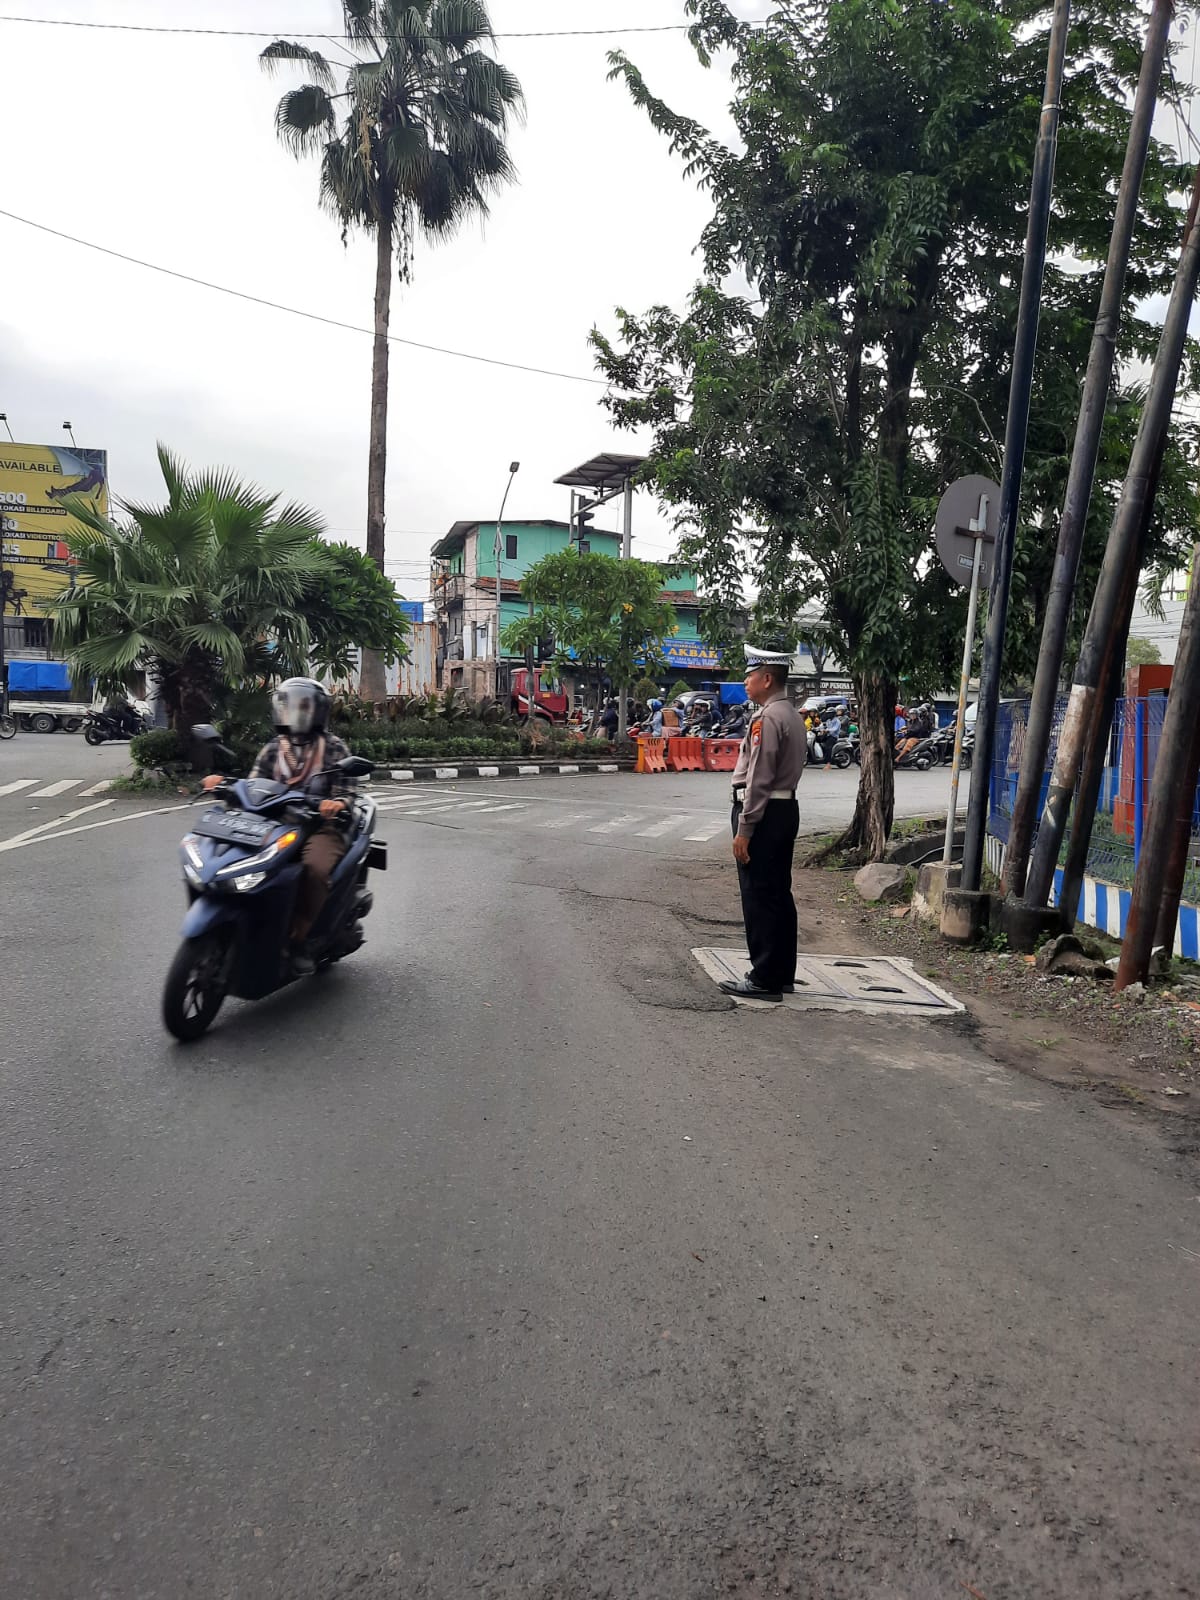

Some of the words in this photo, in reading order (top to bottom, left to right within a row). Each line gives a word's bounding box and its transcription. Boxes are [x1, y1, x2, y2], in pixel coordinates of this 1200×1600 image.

[0, 460, 60, 473] AVAILABLE
[26, 507, 66, 515] BILLBOARD
[668, 647, 718, 658] AKBAR
